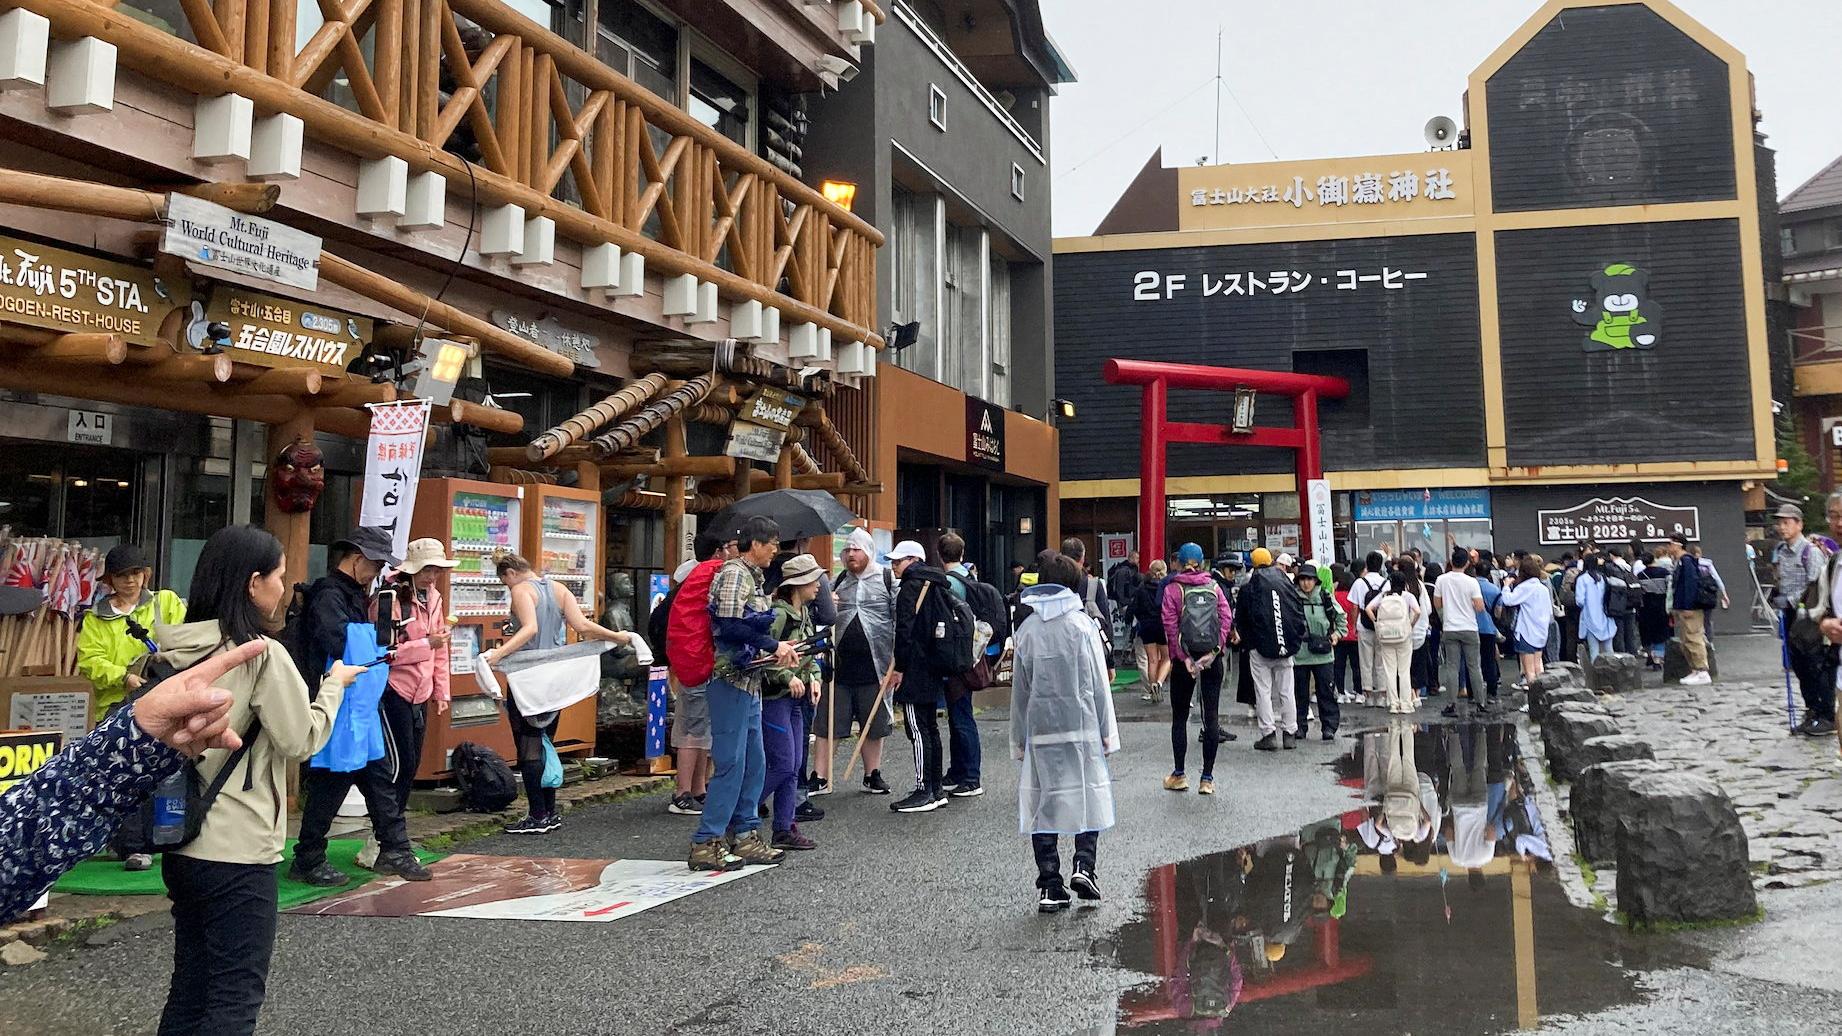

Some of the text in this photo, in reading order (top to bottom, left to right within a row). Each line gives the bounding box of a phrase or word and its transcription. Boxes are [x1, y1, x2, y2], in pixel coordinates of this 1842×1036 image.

[1283, 168, 1457, 208] 小御嶽神社
[181, 219, 310, 271] World Cultural Heritage
[0, 248, 149, 314] t. Fuji 5TH STA.
[1134, 267, 1427, 301] 2F レストラン・コーヒー
[234, 323, 348, 366] 五合園レストハウス
[76, 412, 105, 429] 入口
[1546, 524, 1589, 540] 富士山
[1271, 589, 1286, 647] DUNLOP
